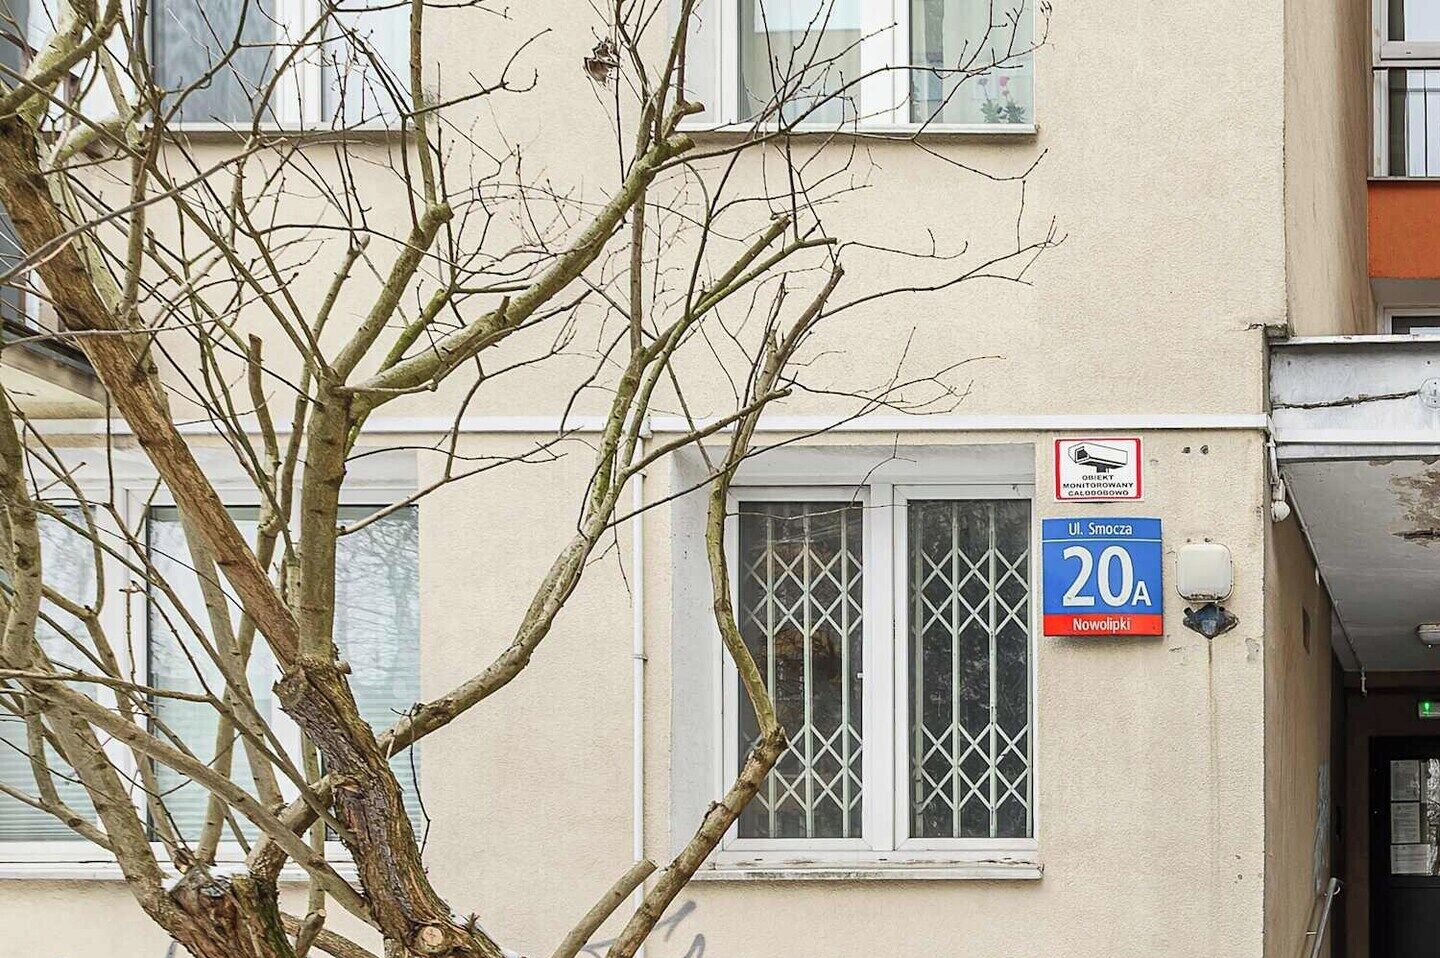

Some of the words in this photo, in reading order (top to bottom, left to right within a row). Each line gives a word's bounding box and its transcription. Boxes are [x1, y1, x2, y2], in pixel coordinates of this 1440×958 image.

[1068, 523, 1084, 535] Ul.
[1088, 523, 1133, 535] Smocza
[1062, 545, 1152, 608] 20A
[1072, 617, 1131, 632] Nowolipki
